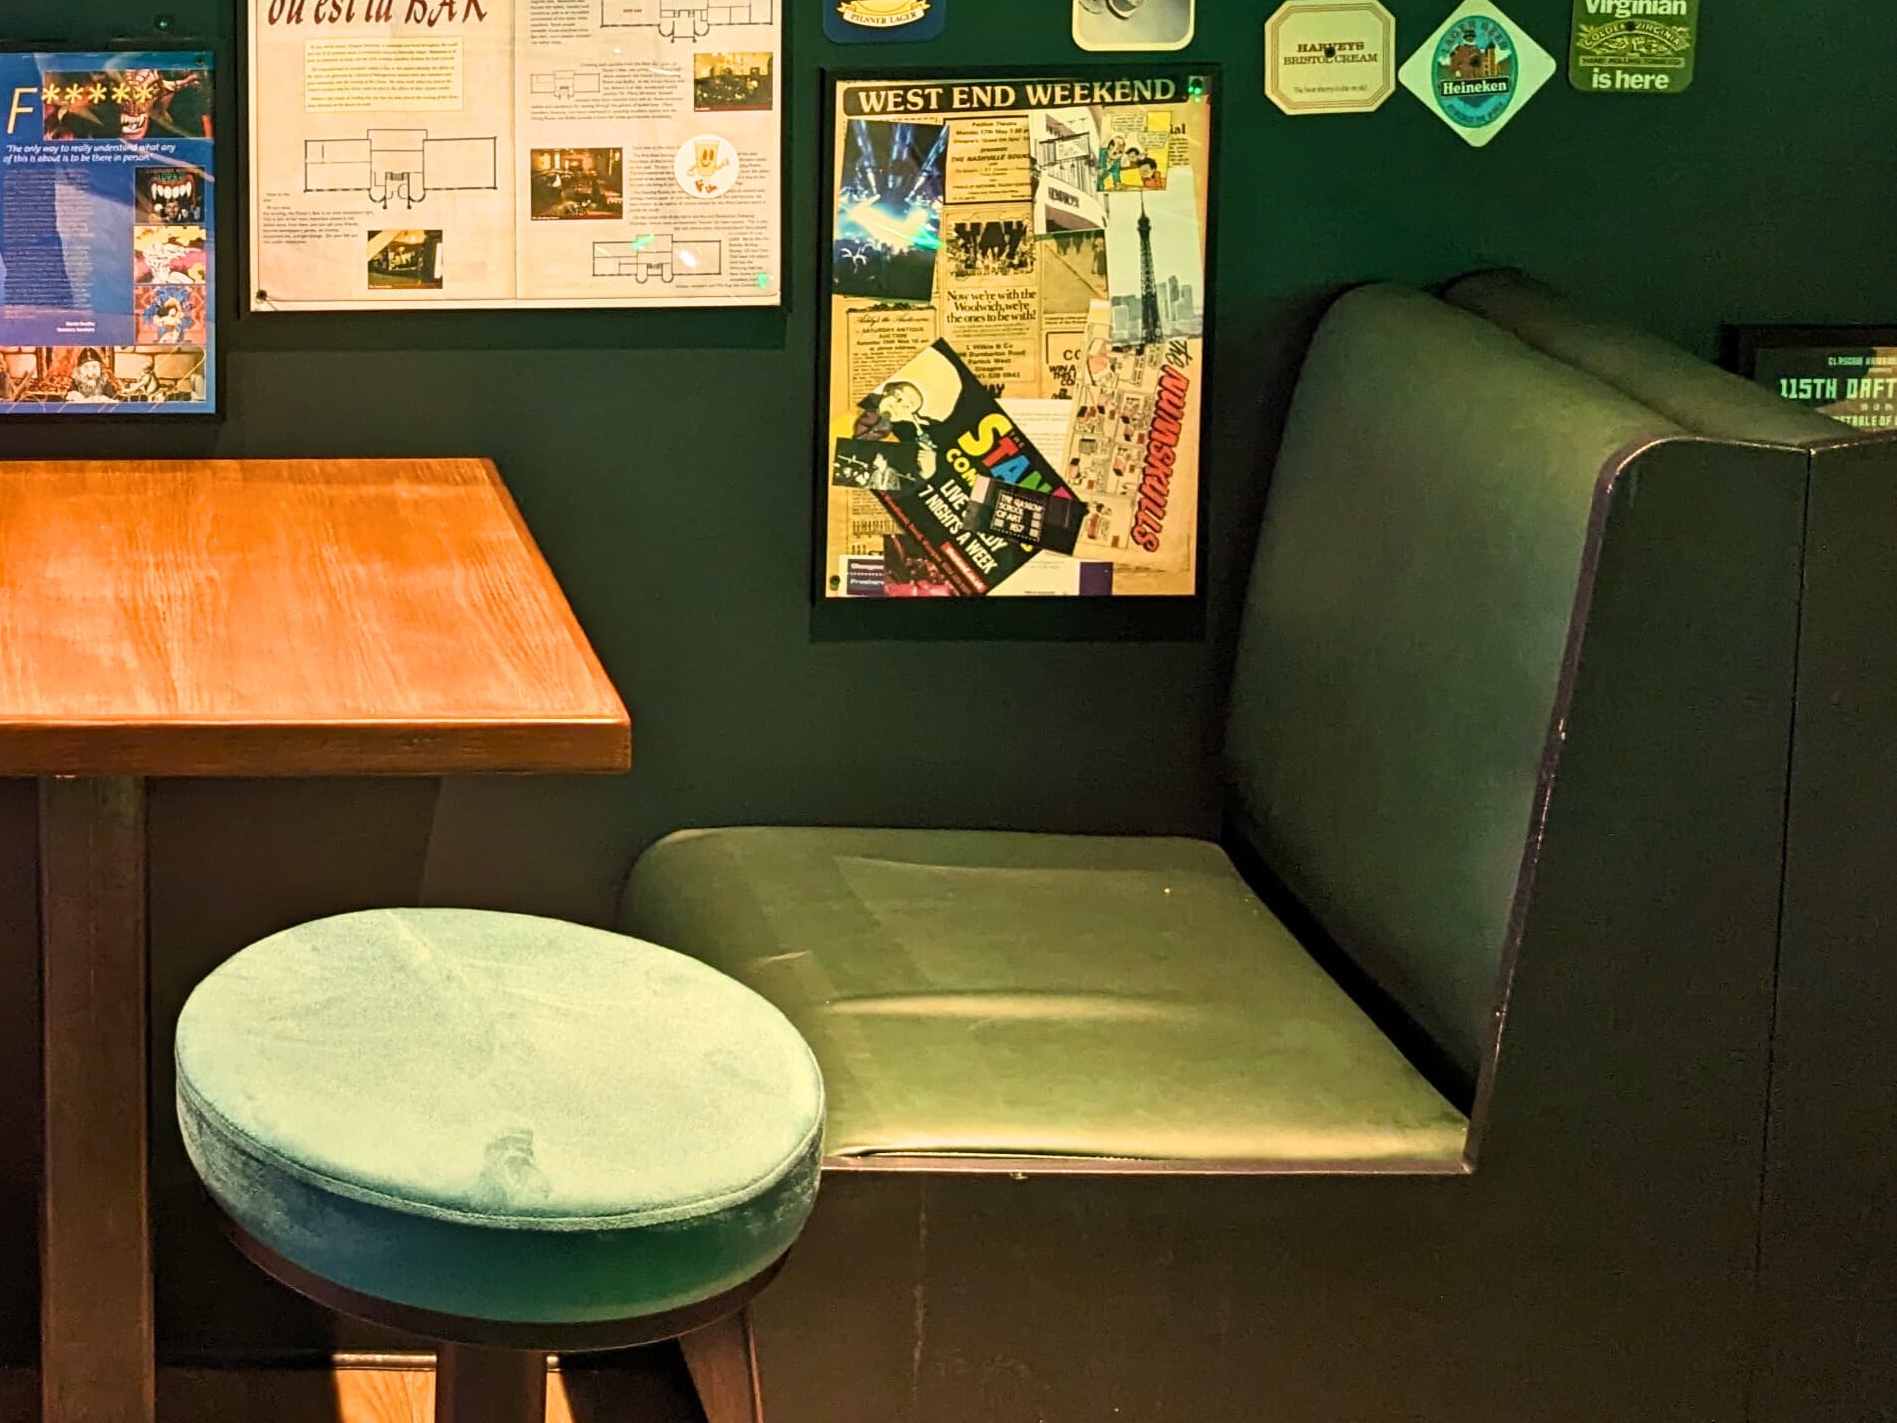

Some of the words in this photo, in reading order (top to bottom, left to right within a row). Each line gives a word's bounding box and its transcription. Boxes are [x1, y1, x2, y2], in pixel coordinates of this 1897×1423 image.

[1297, 41, 1364, 54] HARVEYS
[1442, 78, 1508, 96] Heineken
[1592, 70, 1612, 90] is
[1615, 70, 1670, 90] here
[859, 87, 944, 115] WEST
[952, 84, 1016, 110] END
[1025, 79, 1177, 107] WEEKEND
